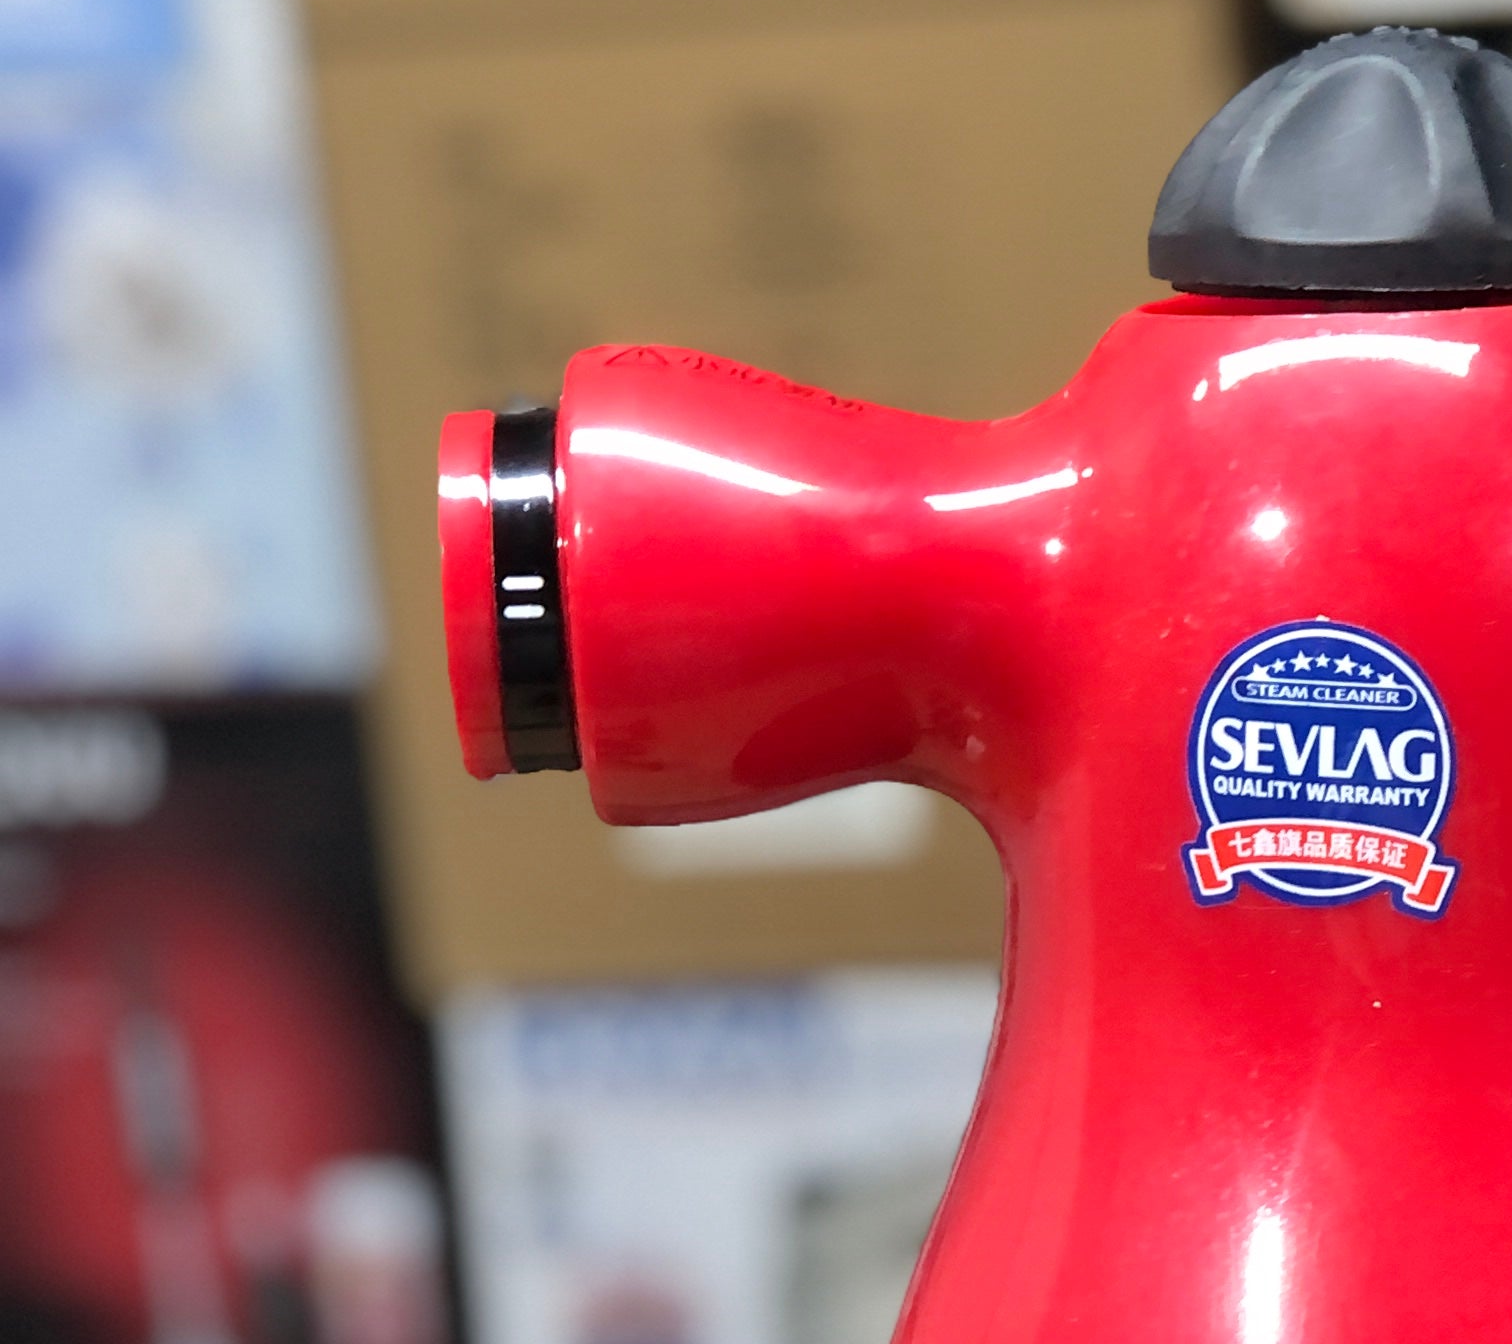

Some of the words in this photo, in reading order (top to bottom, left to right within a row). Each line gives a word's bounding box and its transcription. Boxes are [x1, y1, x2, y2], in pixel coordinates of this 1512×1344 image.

[1246, 682, 1309, 701] STEAM
[1312, 686, 1400, 705] CLEANER
[1210, 717, 1436, 782] SEVLAG
[1213, 776, 1302, 800] QUALITY
[1306, 783, 1430, 807] WARRANTY
[1228, 828, 1408, 869] 七鑫旗品质保证
